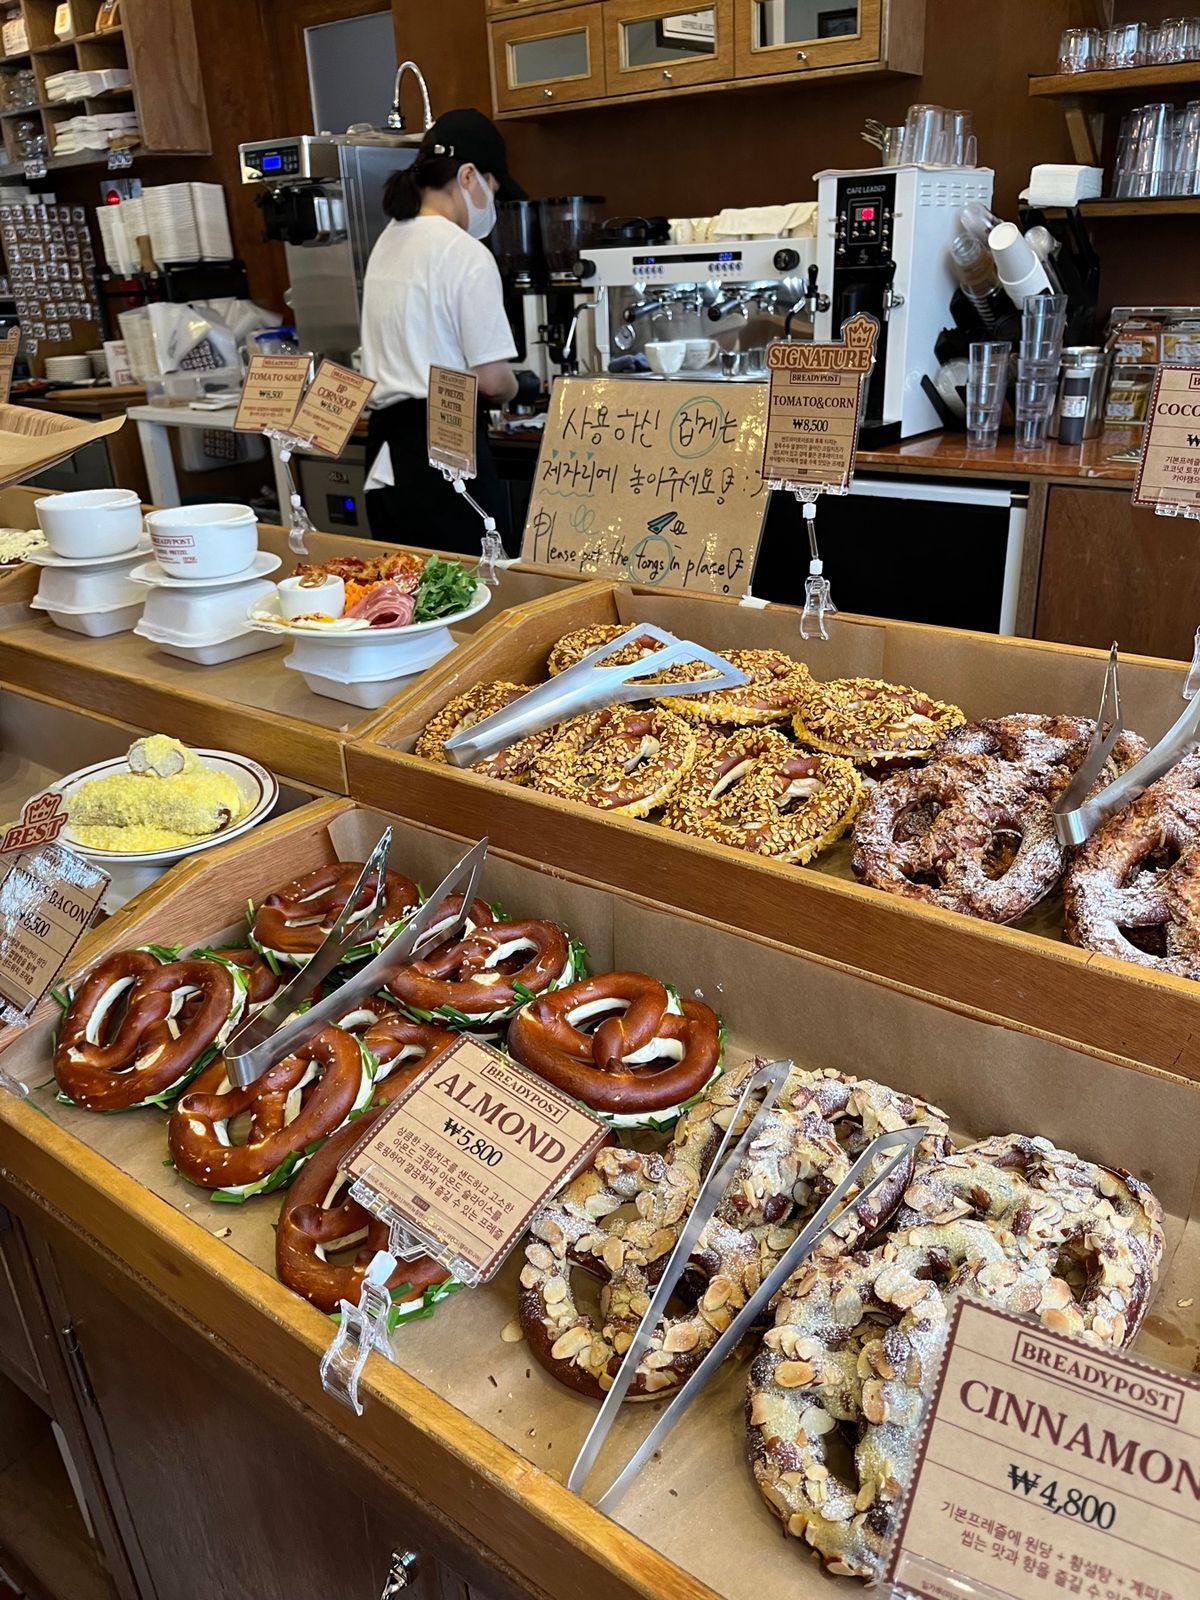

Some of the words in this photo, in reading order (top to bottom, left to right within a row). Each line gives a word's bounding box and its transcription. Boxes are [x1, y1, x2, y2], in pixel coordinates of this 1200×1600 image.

[846, 186, 862, 194] CAFE
[863, 184, 886, 193] LEADER
[769, 346, 871, 368] SIGNATURE
[249, 371, 284, 382] TOMATO
[284, 371, 305, 381] SOUP
[258, 389, 284, 399] ₩8,500
[336, 383, 348, 394] BP
[791, 373, 839, 383] BREADYPOST
[772, 395, 855, 409] TOMATO&CORN
[1157, 403, 1200, 417] COCO
[792, 418, 829, 432] ₩8,500
[542, 459, 618, 495] 제자리에
[1162, 464, 1184, 475] 코코넛
[609, 534, 629, 566] the
[635, 540, 664, 581] tongs
[7, 820, 62, 849] BEST
[48, 889, 89, 924] BACON
[486, 1062, 564, 1118] BREADYPOST
[434, 1072, 568, 1164] ALMOND
[442, 1117, 504, 1168] ₩5,800
[393, 1138, 416, 1159] 아몬드
[415, 1154, 439, 1176] 크림과
[439, 1170, 463, 1193] 아몬드
[461, 1188, 503, 1221] 슬라이스를
[397, 1126, 421, 1147] 상큼한
[419, 1142, 459, 1173] 크림치즈를
[459, 1168, 489, 1195] 샌드하고
[488, 1191, 515, 1215] 고소한
[374, 1141, 407, 1168] 토핑하여
[404, 1162, 437, 1190] 깔끔하게
[434, 1184, 454, 1203] 즐길
[452, 1198, 461, 1209] 수
[459, 1203, 478, 1222] 있는
[477, 1216, 505, 1240] 프레즐
[1020, 1340, 1176, 1413] BREADYPOST
[959, 1379, 1200, 1502] CINNAMON
[1007, 1464, 1117, 1530] ₩4,800
[940, 1500, 1023, 1546] 기본프레즐에
[1025, 1535, 1053, 1560] 원당
[1056, 1551, 1065, 1562] +
[1068, 1553, 1113, 1585] 황설탕
[960, 1528, 988, 1554] 씹는
[992, 1541, 1019, 1567] 맛과
[1022, 1553, 1051, 1580] 향을
[1054, 1567, 1083, 1595] 즐길
[1086, 1582, 1100, 1598] 수
